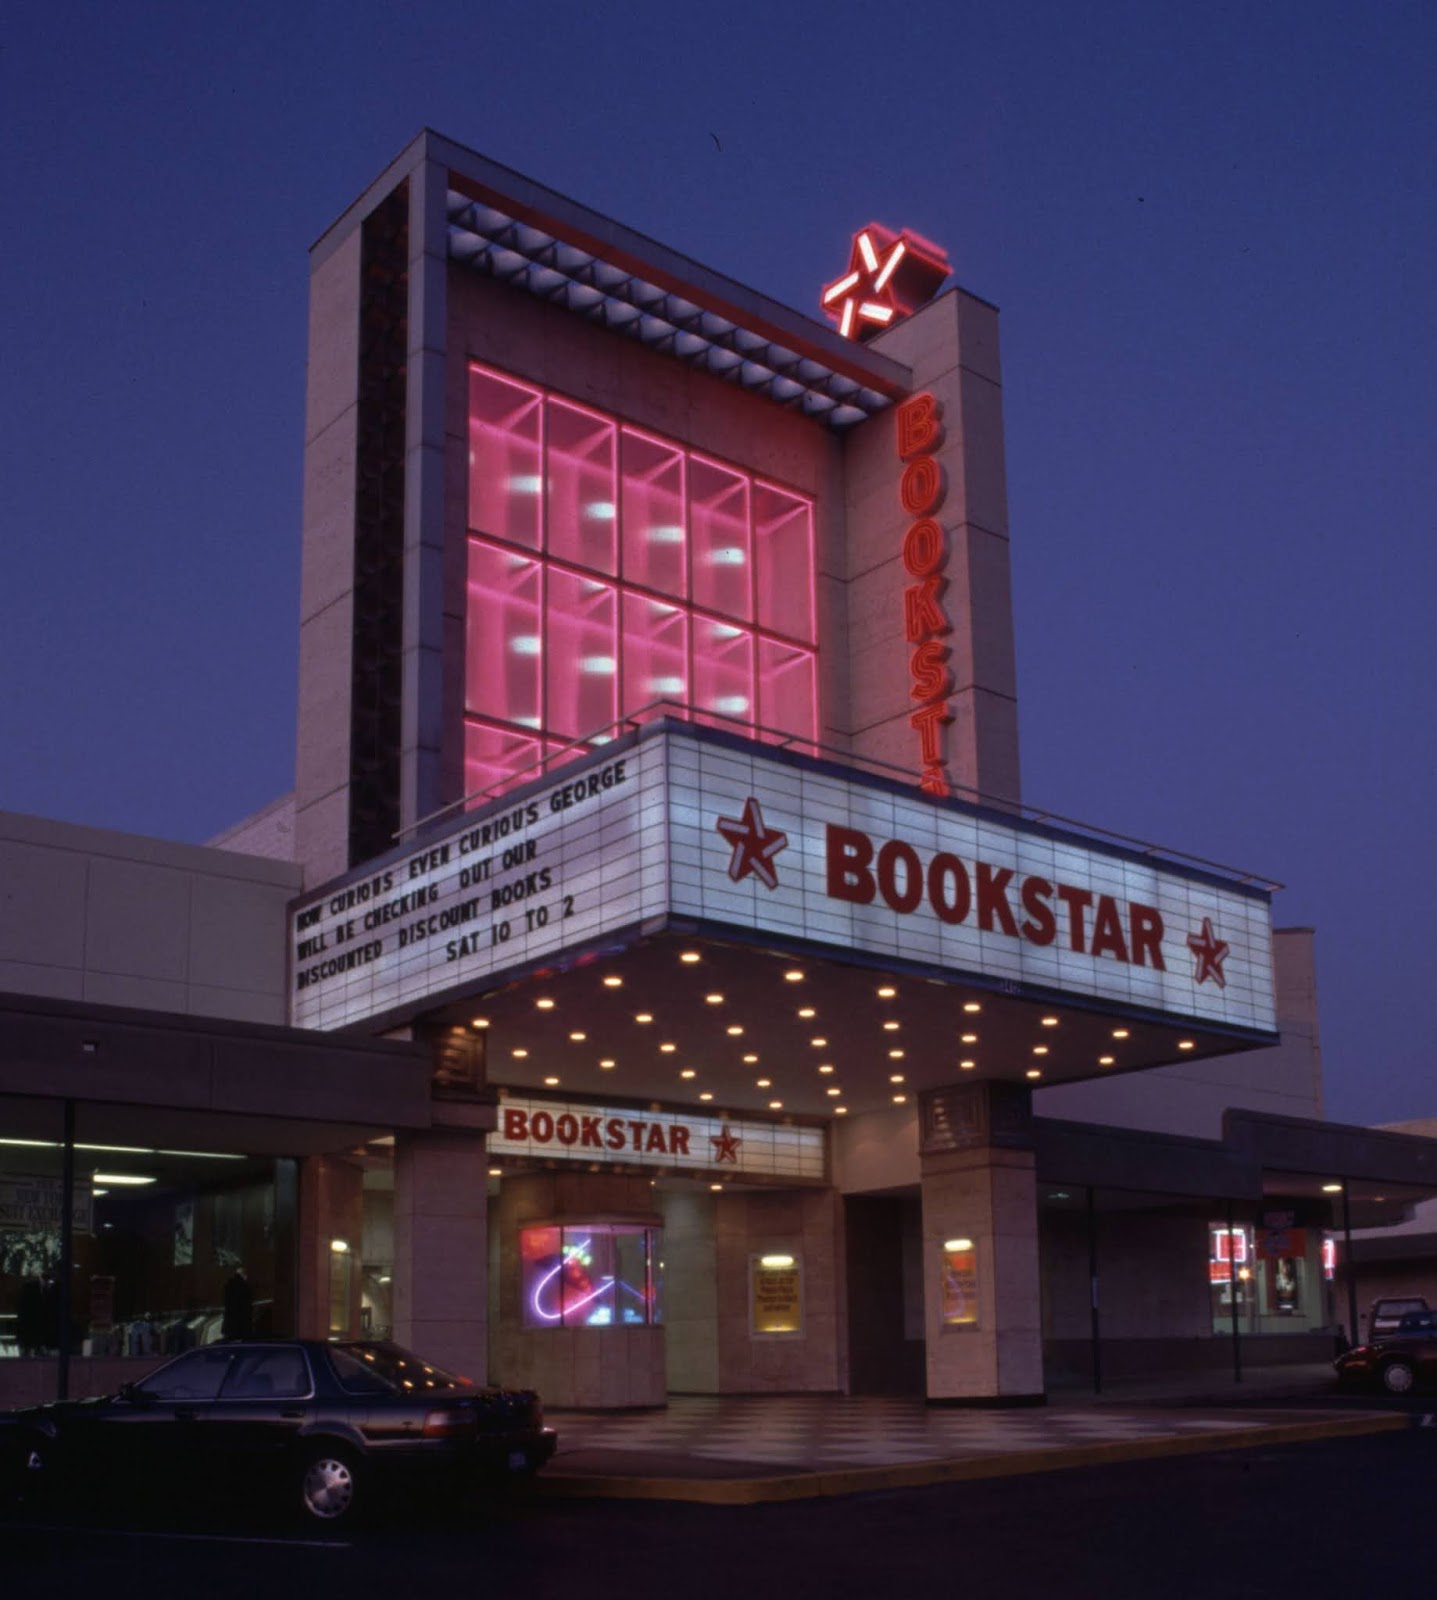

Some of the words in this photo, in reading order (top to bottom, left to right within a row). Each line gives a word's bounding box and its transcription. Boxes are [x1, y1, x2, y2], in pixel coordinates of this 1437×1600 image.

[330, 871, 393, 915] CURIOUS
[409, 844, 450, 879] EVEN
[459, 802, 539, 855] CURIOUS
[550, 760, 626, 812] GEORGE
[825, 822, 1167, 971] BOOKSTAR
[297, 933, 328, 961] WILL
[336, 920, 355, 944] BE
[364, 882, 438, 930] CHECKING
[460, 857, 491, 889] OUT
[502, 839, 537, 870] OUR
[297, 939, 382, 989] DISCOUNTED
[399, 897, 480, 949] DISCOUNT
[491, 867, 552, 911] BOOKS
[446, 931, 480, 961] SAT
[492, 920, 511, 946] 10
[525, 906, 548, 932] TO
[563, 895, 576, 918] 2
[503, 1108, 691, 1155] BOOKSTAR
